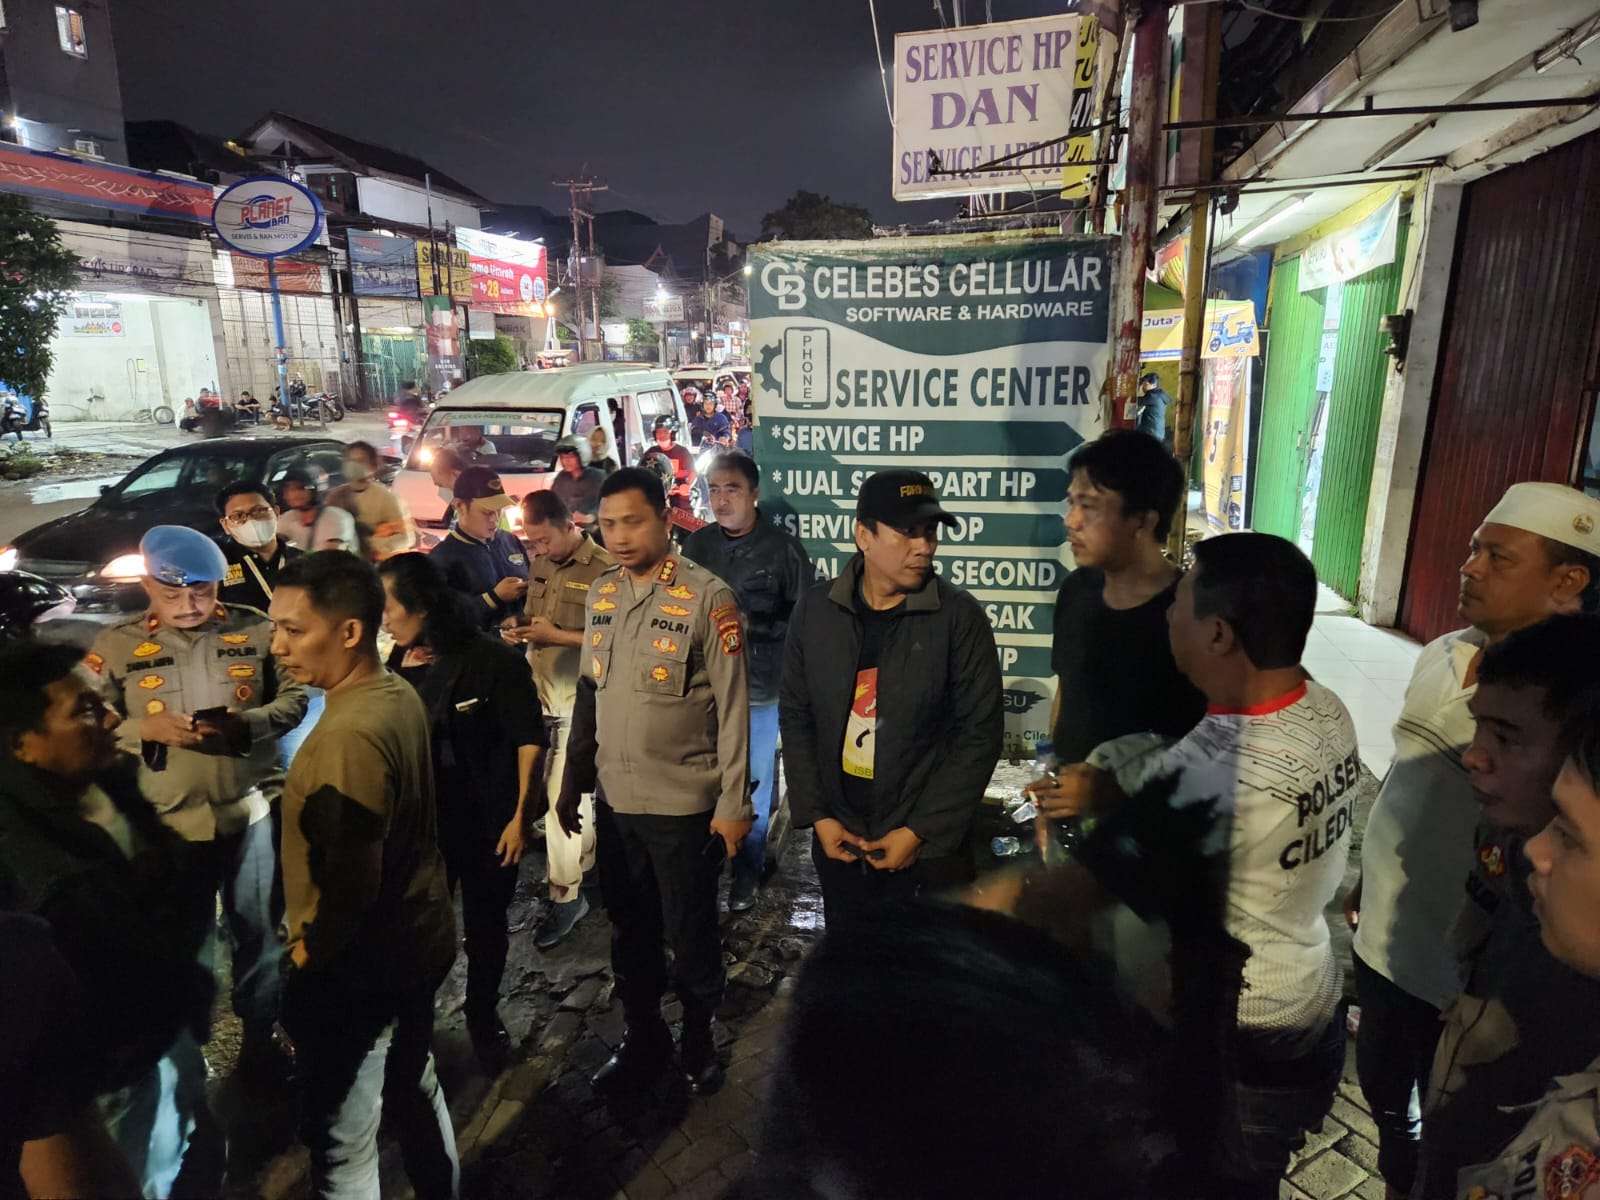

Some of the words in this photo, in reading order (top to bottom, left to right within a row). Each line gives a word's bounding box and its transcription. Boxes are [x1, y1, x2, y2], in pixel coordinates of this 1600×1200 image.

[905, 35, 1023, 83] SERVICE
[1032, 30, 1072, 71] HP
[930, 83, 1040, 130] DAN
[901, 146, 982, 185] SERVICE
[241, 195, 293, 225] PLANET
[271, 215, 290, 227] BAN
[813, 266, 940, 299] CELEBES
[949, 257, 1102, 297] CELLULAR
[845, 306, 952, 323] SOFTWARE
[958, 306, 971, 320] &
[977, 301, 1093, 321] HARDWARE
[802, 335, 812, 399] PHONE
[835, 368, 958, 408] SERVICE
[970, 366, 1091, 407] CENTER
[889, 425, 925, 452] HP
[1000, 471, 1036, 497] HP
[951, 560, 1056, 587] SECOND
[651, 618, 690, 635] POLRI
